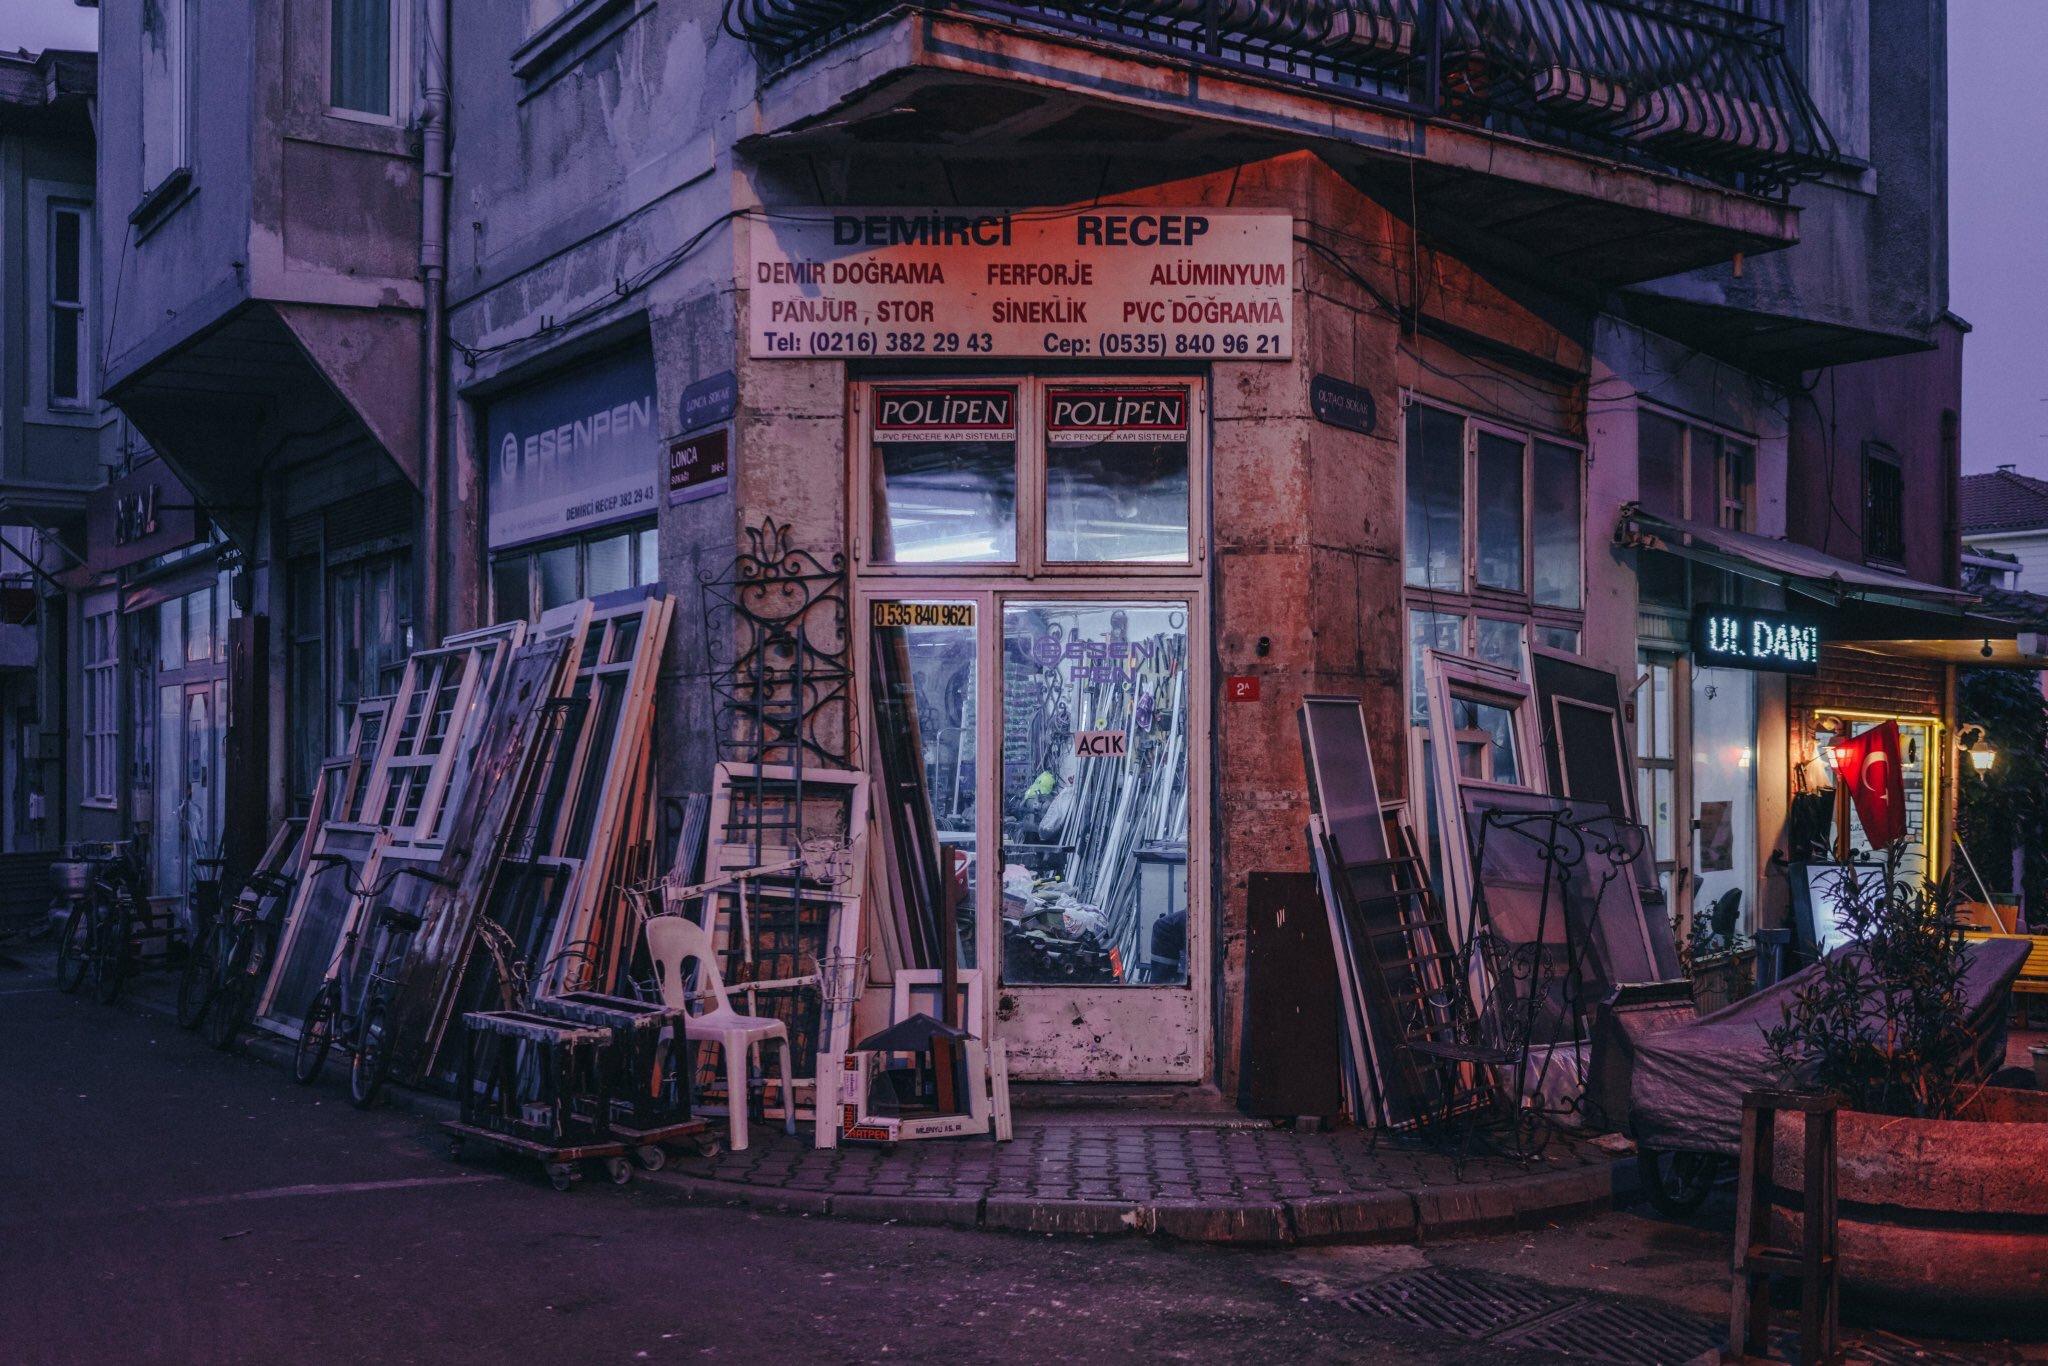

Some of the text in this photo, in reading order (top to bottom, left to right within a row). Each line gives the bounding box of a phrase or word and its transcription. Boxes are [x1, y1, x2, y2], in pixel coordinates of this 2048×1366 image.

[833, 209, 1210, 246] DEMİRCİ RECEP
[757, 256, 945, 285] DEMİR DOĞRAMA
[1150, 259, 1285, 286] ALÜMINYUM
[877, 300, 934, 323] STOR
[992, 297, 1087, 324] SİNEKLİK
[1123, 296, 1284, 324] PVC DOĞRAMA
[764, 331, 993, 355] Tel: (0216) 382 29 43
[1043, 333, 1281, 357] Cep: (0535) 840 96 21
[881, 394, 1008, 425] POLİPEN
[1053, 396, 1181, 426] POLİPEN
[524, 396, 651, 464] ESENPEN
[1116, 433, 1136, 441] KAPI
[671, 446, 698, 470] LONCA
[595, 495, 618, 513] RECEP
[619, 491, 632, 507] 382
[634, 488, 643, 503] 29
[645, 486, 654, 500] 43
[876, 604, 973, 626] 0 535 840 9621
[1236, 682, 1250, 696] 2A
[1076, 735, 1124, 756] AÇIK
